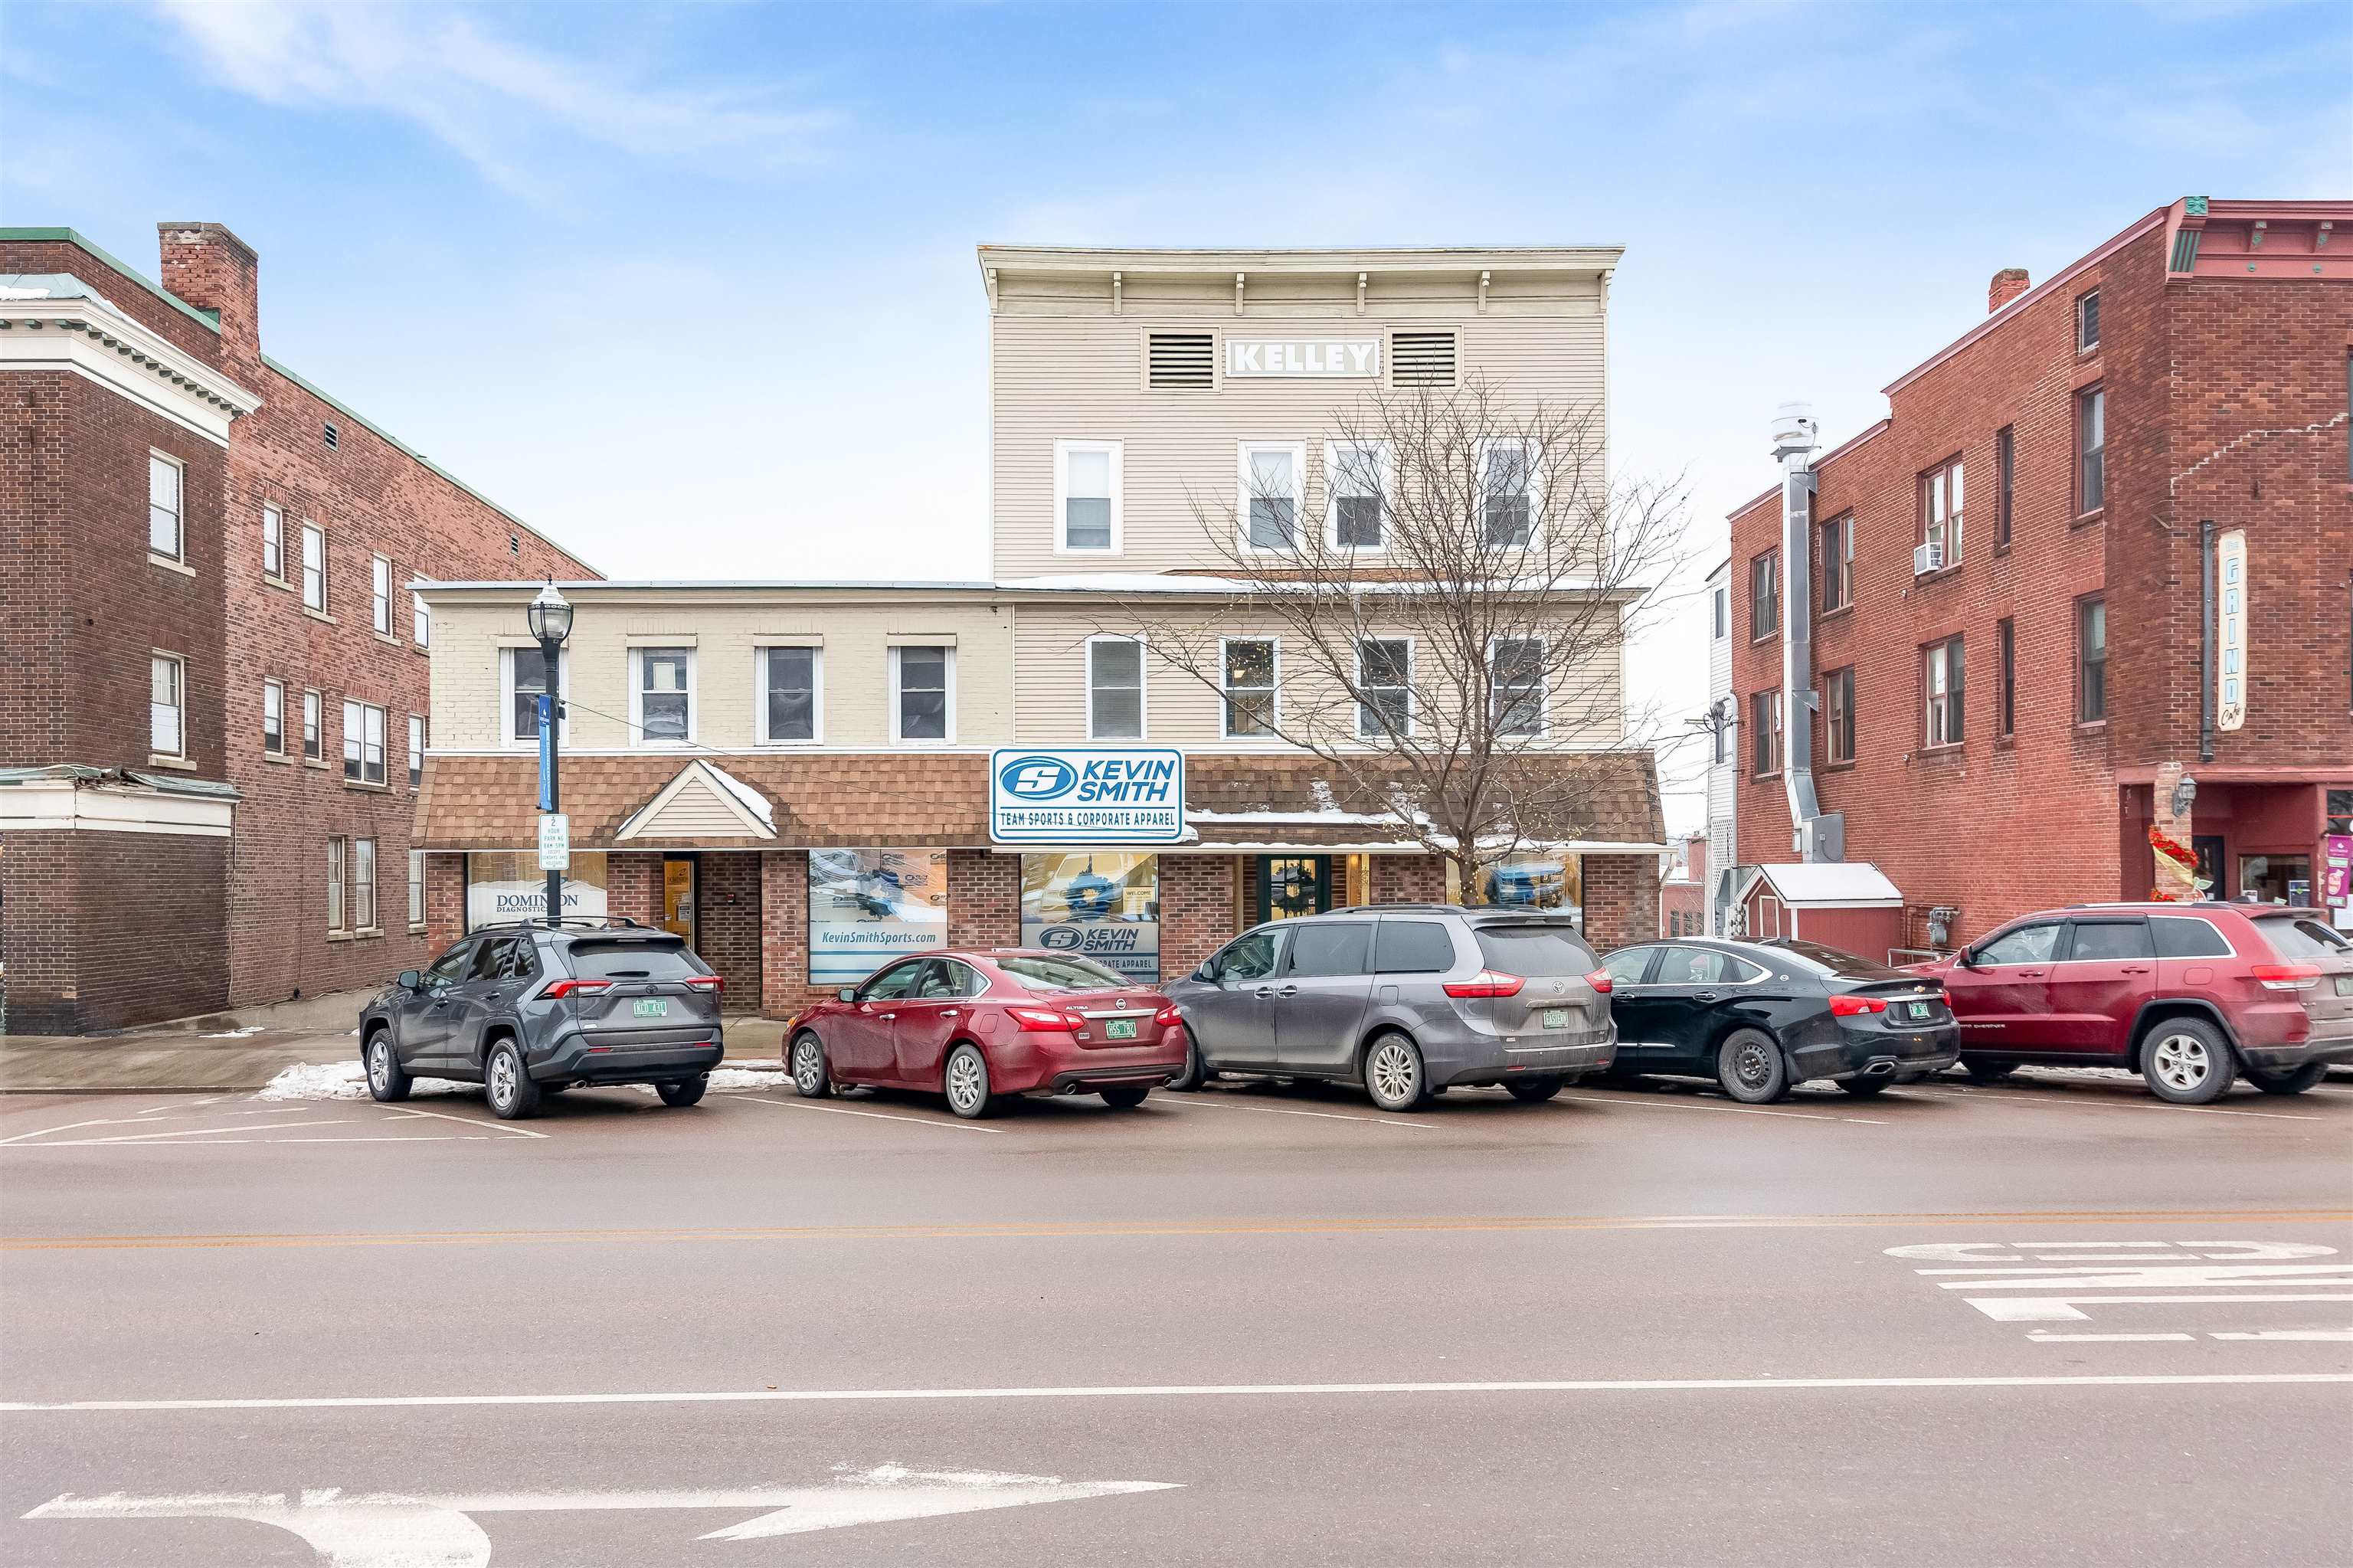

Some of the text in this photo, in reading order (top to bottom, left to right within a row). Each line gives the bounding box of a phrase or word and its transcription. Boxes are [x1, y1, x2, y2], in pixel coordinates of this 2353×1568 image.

[1235, 344, 1373, 372] KELLEY
[1082, 760, 1175, 780] KEVIN
[1077, 781, 1170, 802] SMITH
[1000, 813, 1175, 826] TEAM SPORTS & CORPORATE APPAREL
[497, 895, 579, 906] DOMINON
[822, 931, 936, 945] KevinSmithSports.com
[1085, 928, 1139, 940] KEVIN
[1083, 940, 1136, 951] SMITH
[1122, 960, 1152, 968] APPAREL
